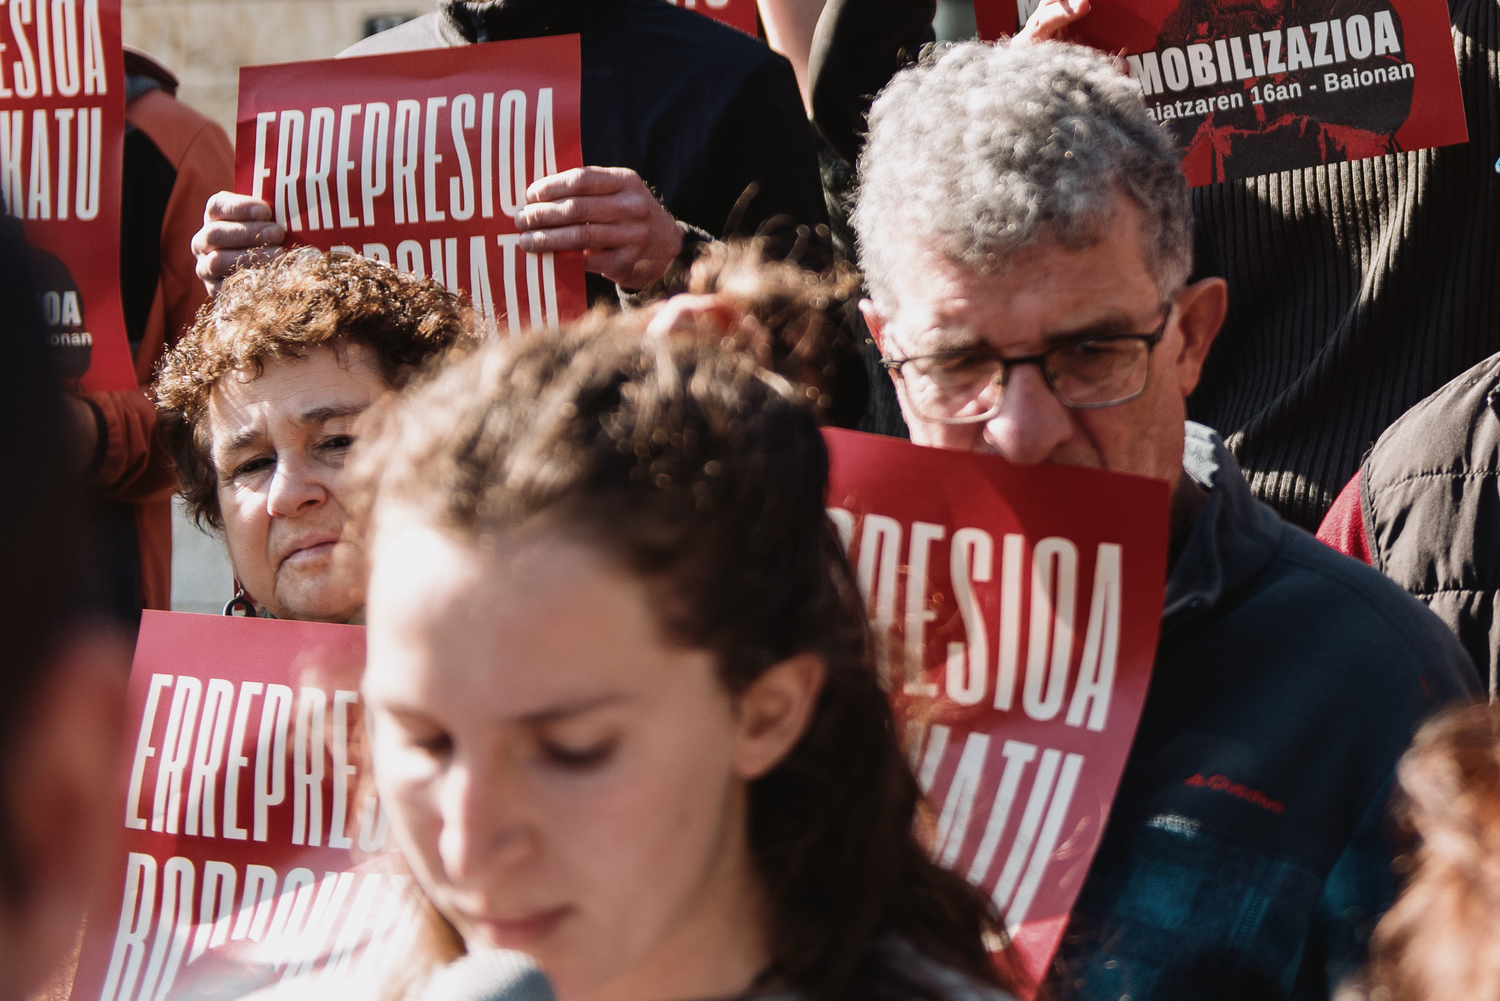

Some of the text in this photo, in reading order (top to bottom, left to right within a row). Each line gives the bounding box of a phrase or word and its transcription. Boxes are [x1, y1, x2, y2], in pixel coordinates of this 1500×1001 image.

[1126, 9, 1402, 96] MOBILIZAZIOA
[1145, 90, 1244, 122] aiatzaren
[1251, 83, 1303, 105] 16an
[1324, 62, 1416, 93] Baionan
[0, 107, 102, 221] KATU
[252, 87, 557, 232] ERREPRESIOA
